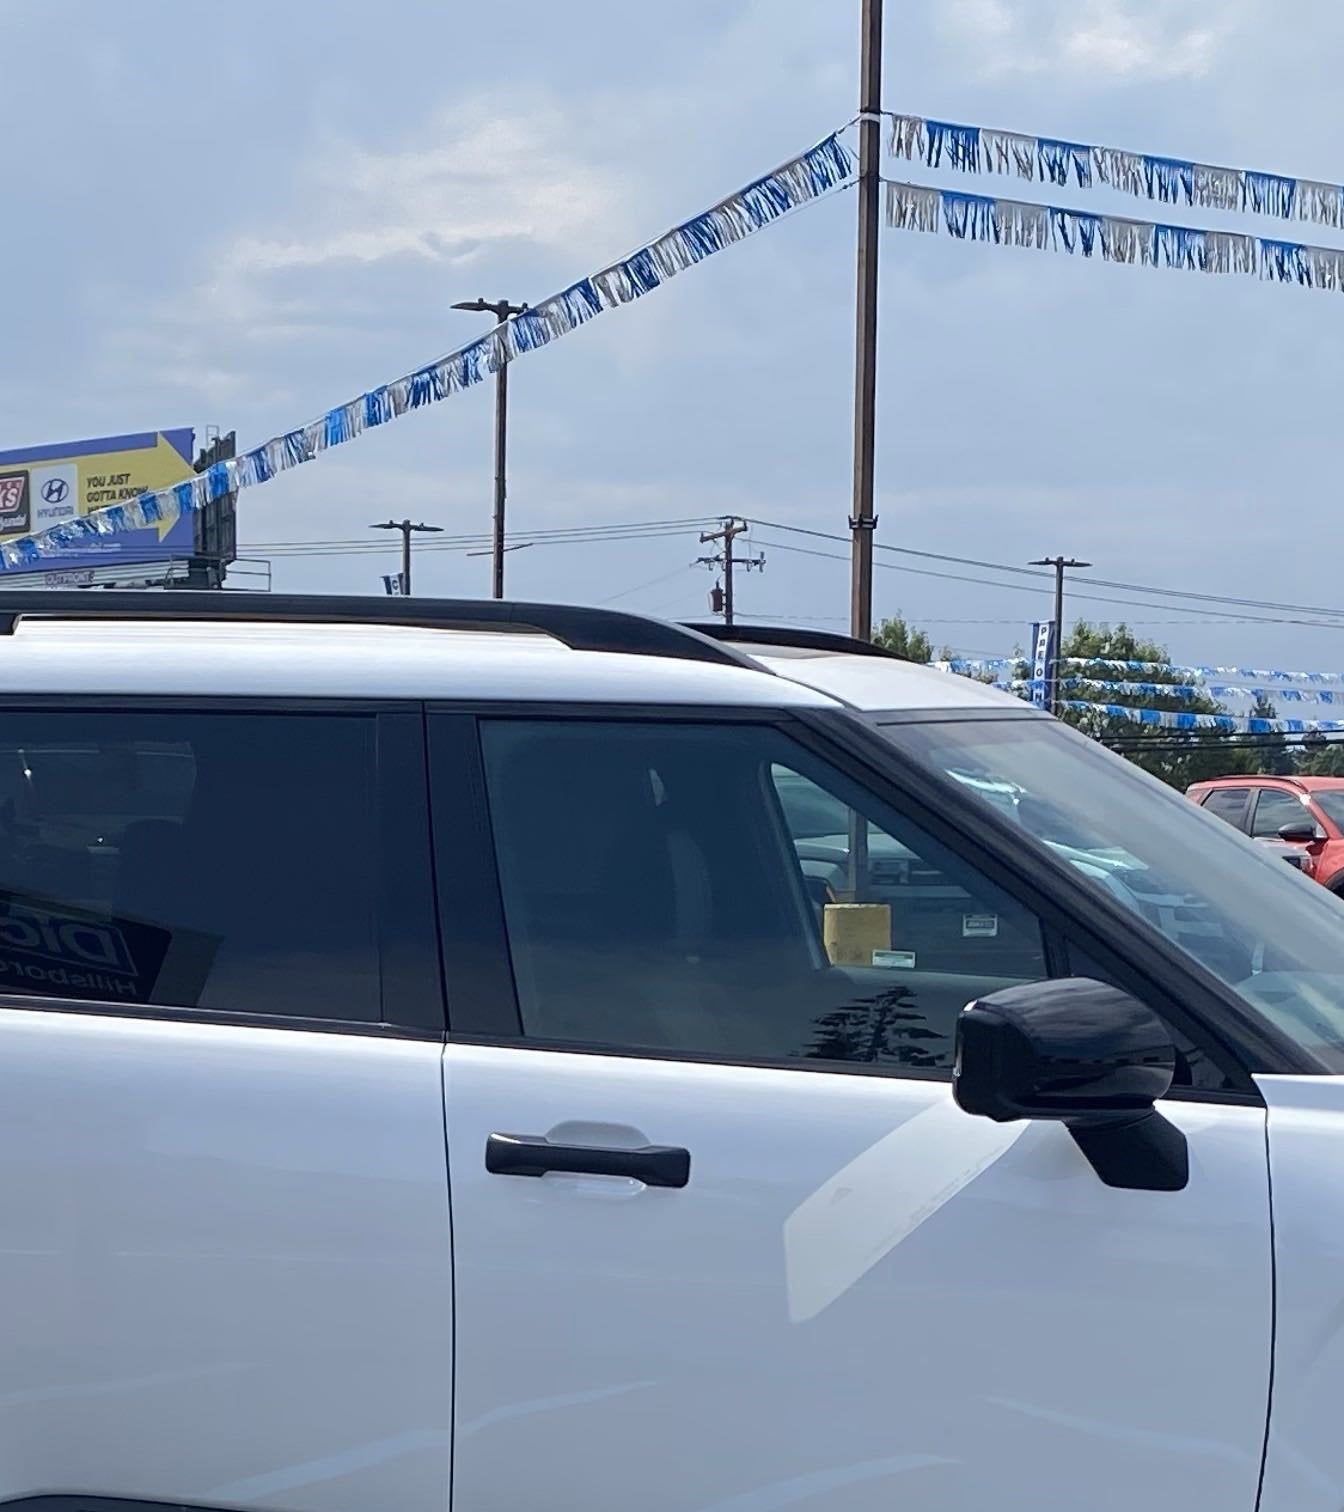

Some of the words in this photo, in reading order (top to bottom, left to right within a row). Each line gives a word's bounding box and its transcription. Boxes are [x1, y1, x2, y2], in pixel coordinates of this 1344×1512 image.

[87, 476, 106, 488] YOU
[107, 473, 131, 486] JUST
[87, 490, 116, 502] GOTTA
